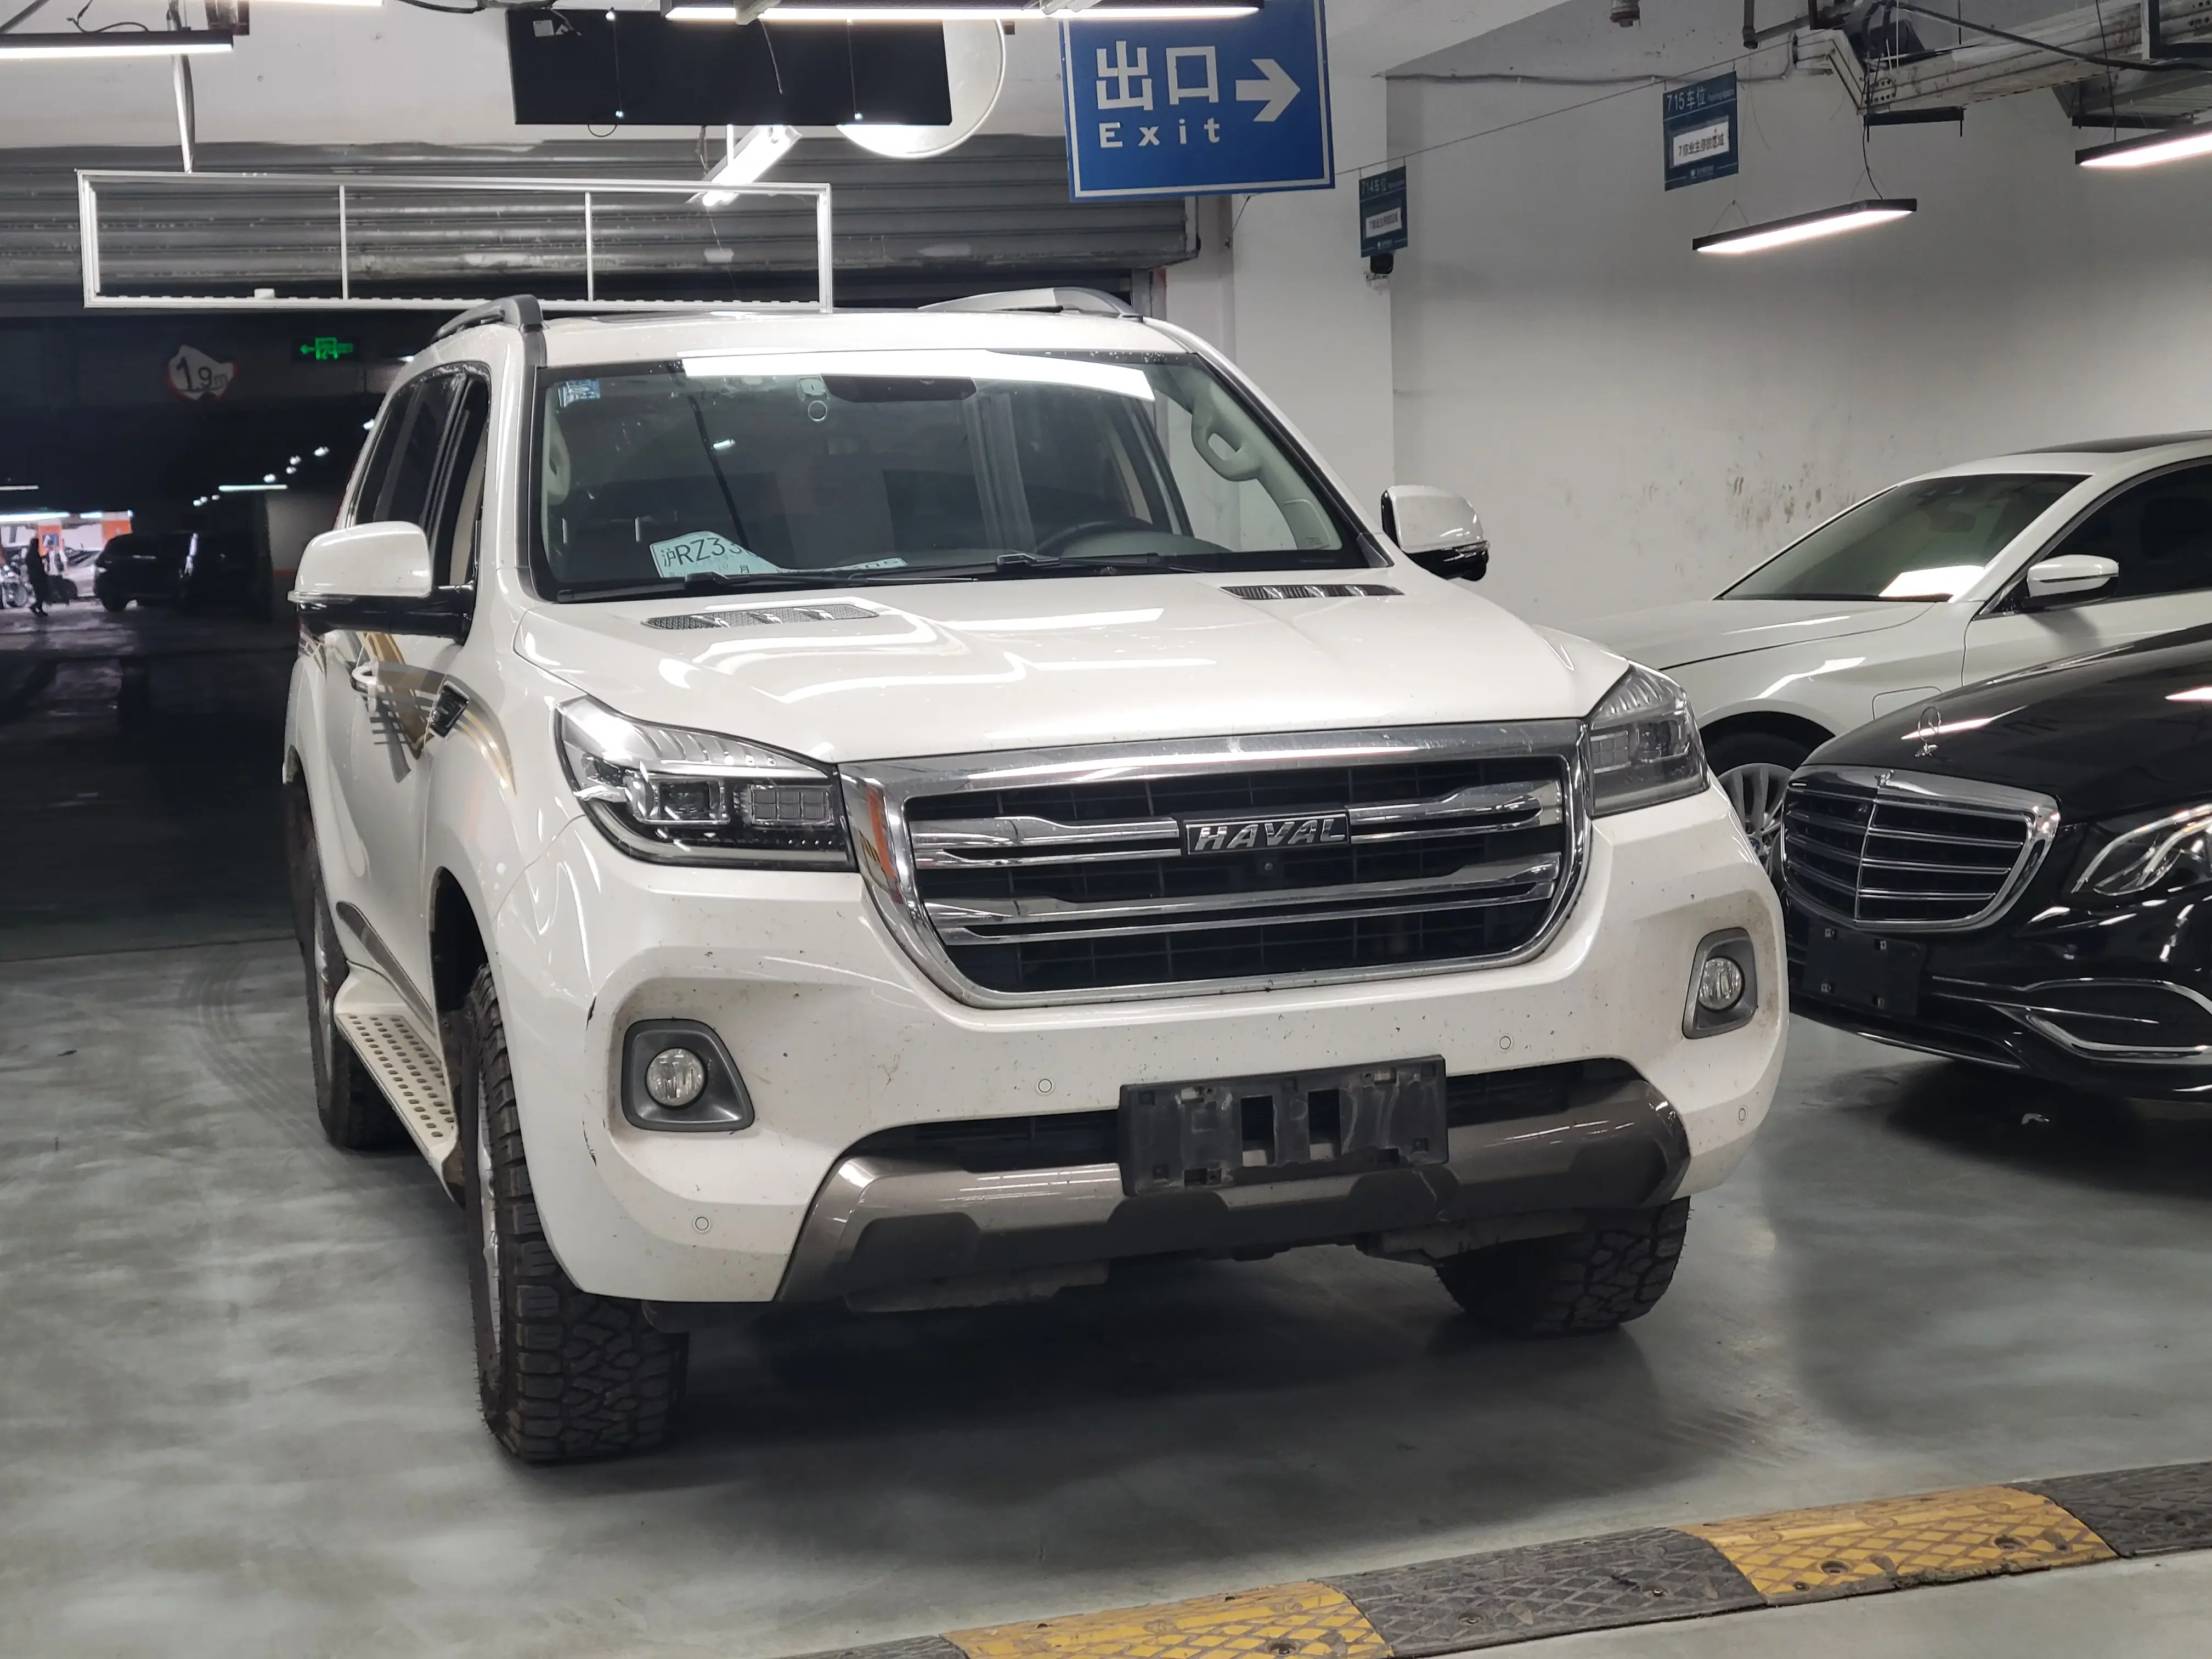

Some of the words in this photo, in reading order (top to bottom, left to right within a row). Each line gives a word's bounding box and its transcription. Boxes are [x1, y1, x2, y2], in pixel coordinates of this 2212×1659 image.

[1096, 40, 1218, 110] 出口
[1667, 86, 1706, 112] 715车位
[1099, 117, 1220, 148] Exit
[660, 537, 757, 567] 沪RZ33
[1194, 819, 1345, 851] HAVAL
